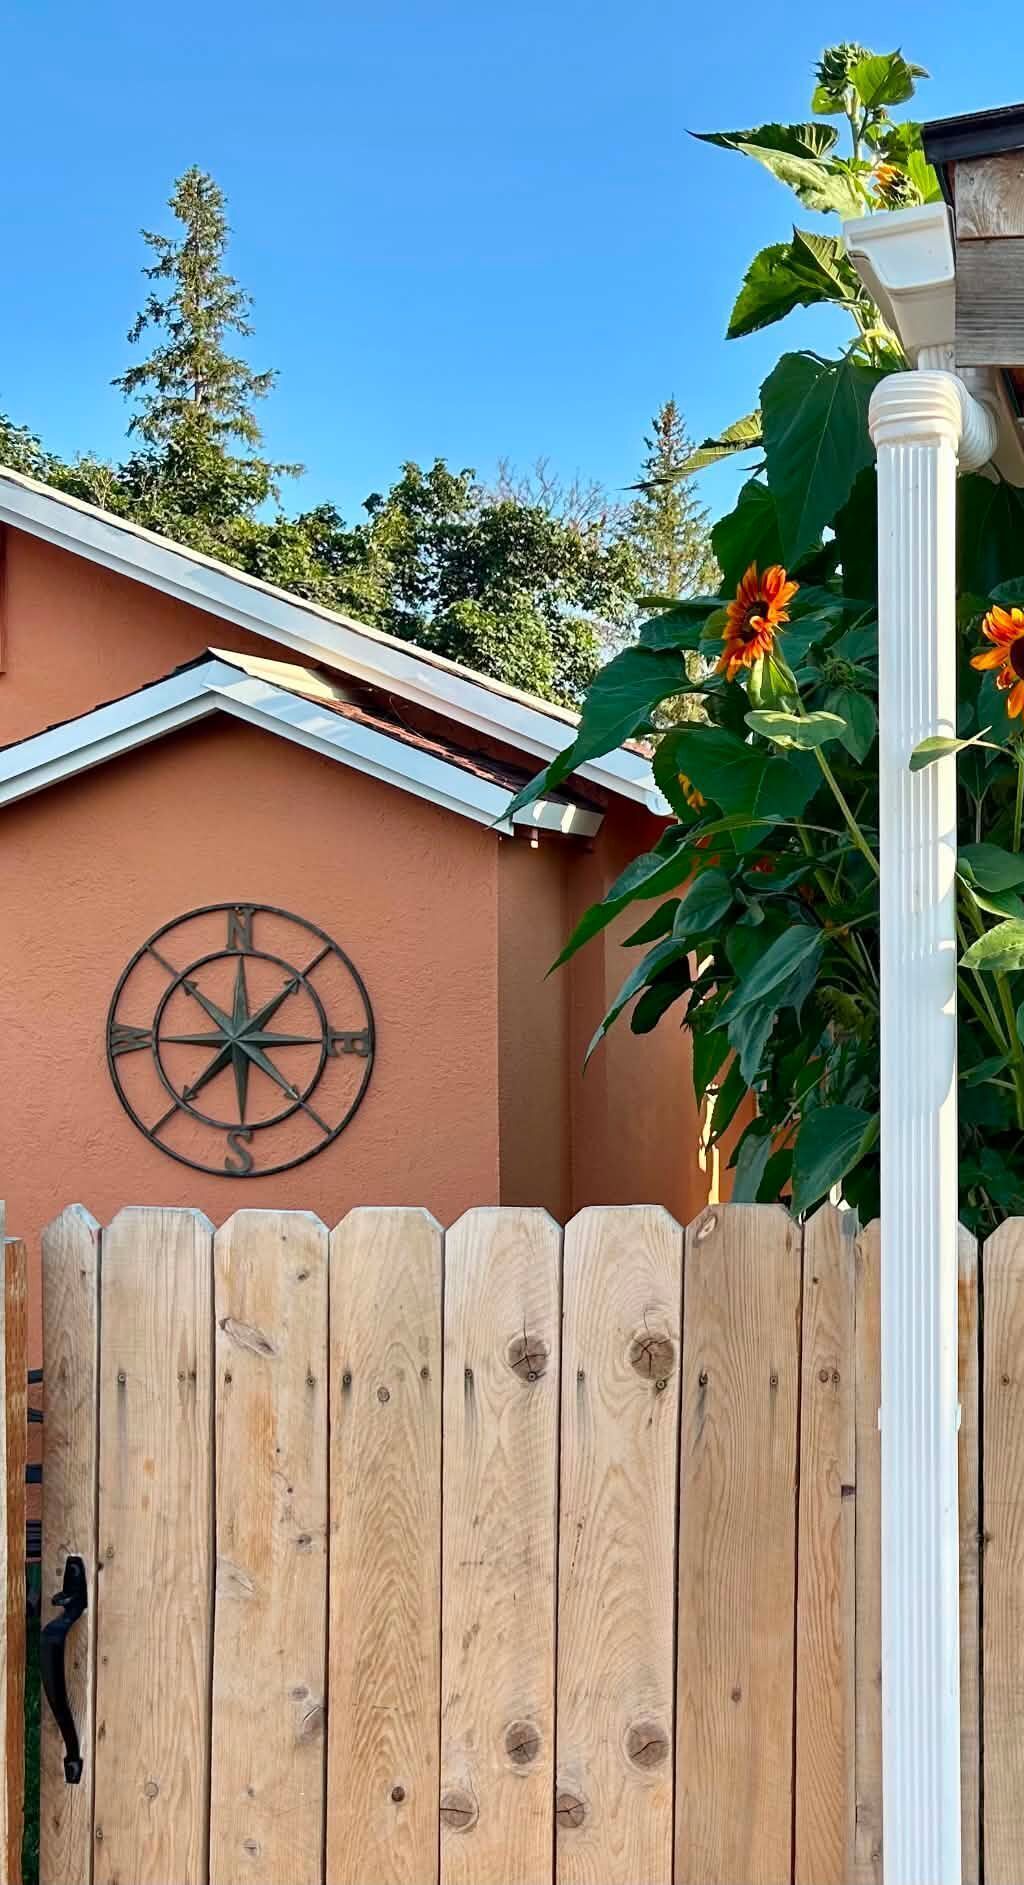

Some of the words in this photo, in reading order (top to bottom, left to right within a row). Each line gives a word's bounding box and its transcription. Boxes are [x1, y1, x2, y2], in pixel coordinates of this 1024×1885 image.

[226, 907, 255, 950] N
[111, 1022, 153, 1057] W
[327, 1026, 371, 1057] E
[224, 1129, 253, 1173] S
